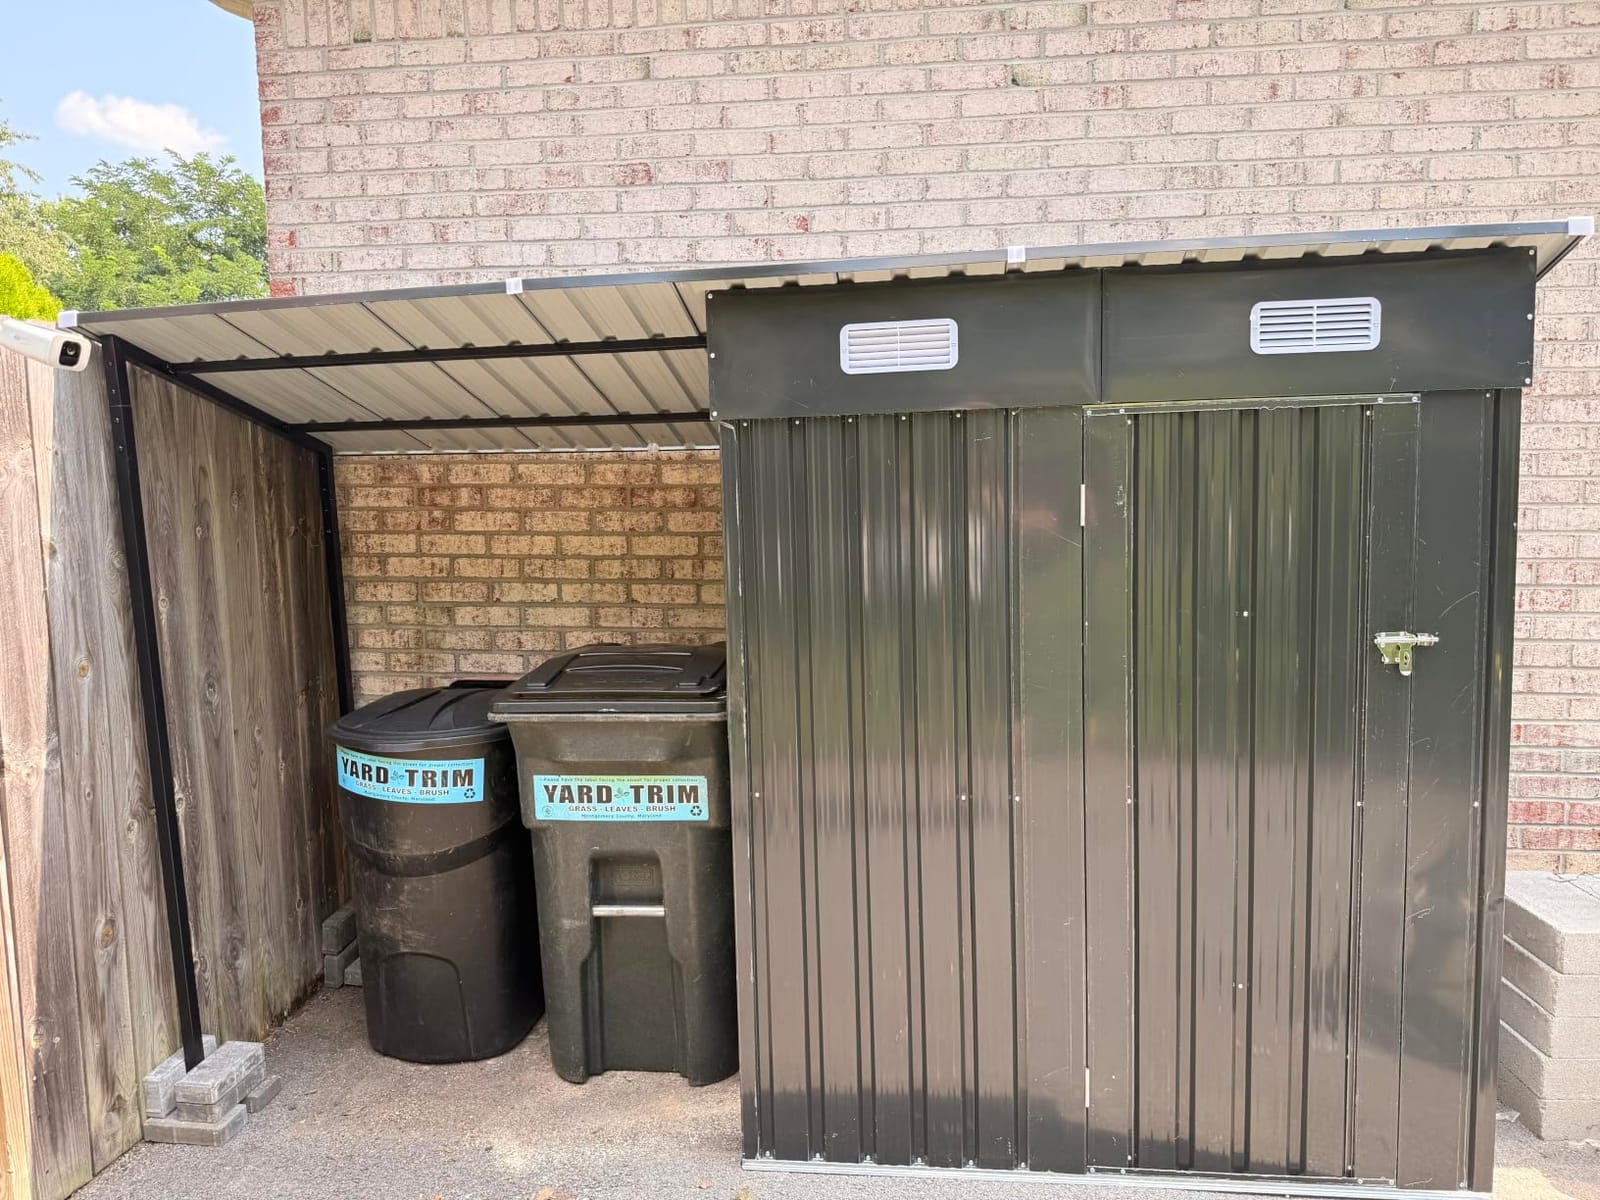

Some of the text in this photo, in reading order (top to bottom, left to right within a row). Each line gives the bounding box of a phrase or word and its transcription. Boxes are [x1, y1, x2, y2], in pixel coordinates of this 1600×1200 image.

[341, 756, 474, 788] YARD TRIM
[355, 780, 377, 790] GRASS
[382, 786, 412, 795] LEAVES
[543, 784, 699, 804] YARD TRIM
[605, 805, 638, 813] LEAVES
